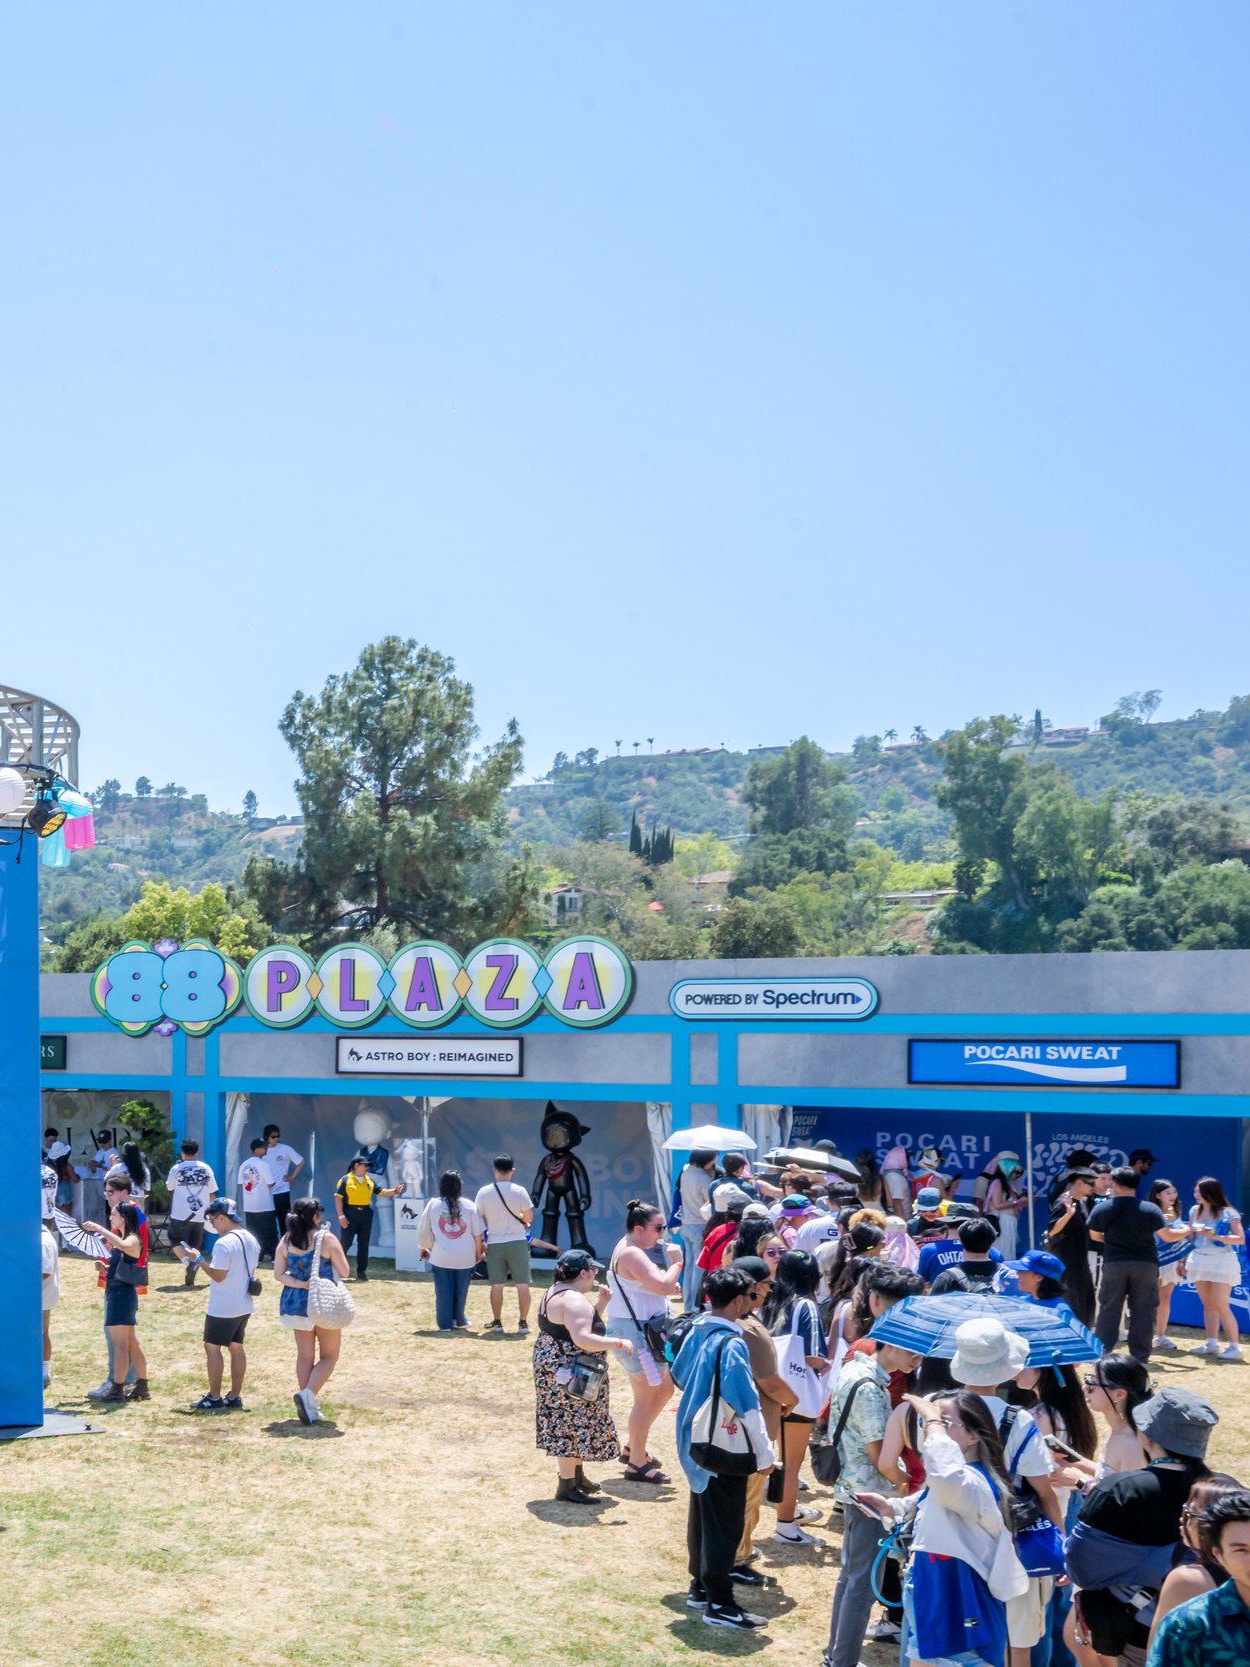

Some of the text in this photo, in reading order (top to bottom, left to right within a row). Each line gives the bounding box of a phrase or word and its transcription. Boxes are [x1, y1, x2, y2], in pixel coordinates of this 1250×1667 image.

[105, 951, 605, 1023] 88 PLAZA
[685, 989, 856, 1009] POWERED BY Spectrum
[365, 1052, 404, 1061] ASTRO
[407, 1052, 431, 1062] BOY
[438, 1052, 514, 1063] REIMAGINED
[963, 1045, 1123, 1060] POCARI SWEAT
[875, 1131, 991, 1153] POCARI
[1051, 1133, 1110, 1144] LOS ANGELES
[937, 1250, 964, 1266] OHTA
